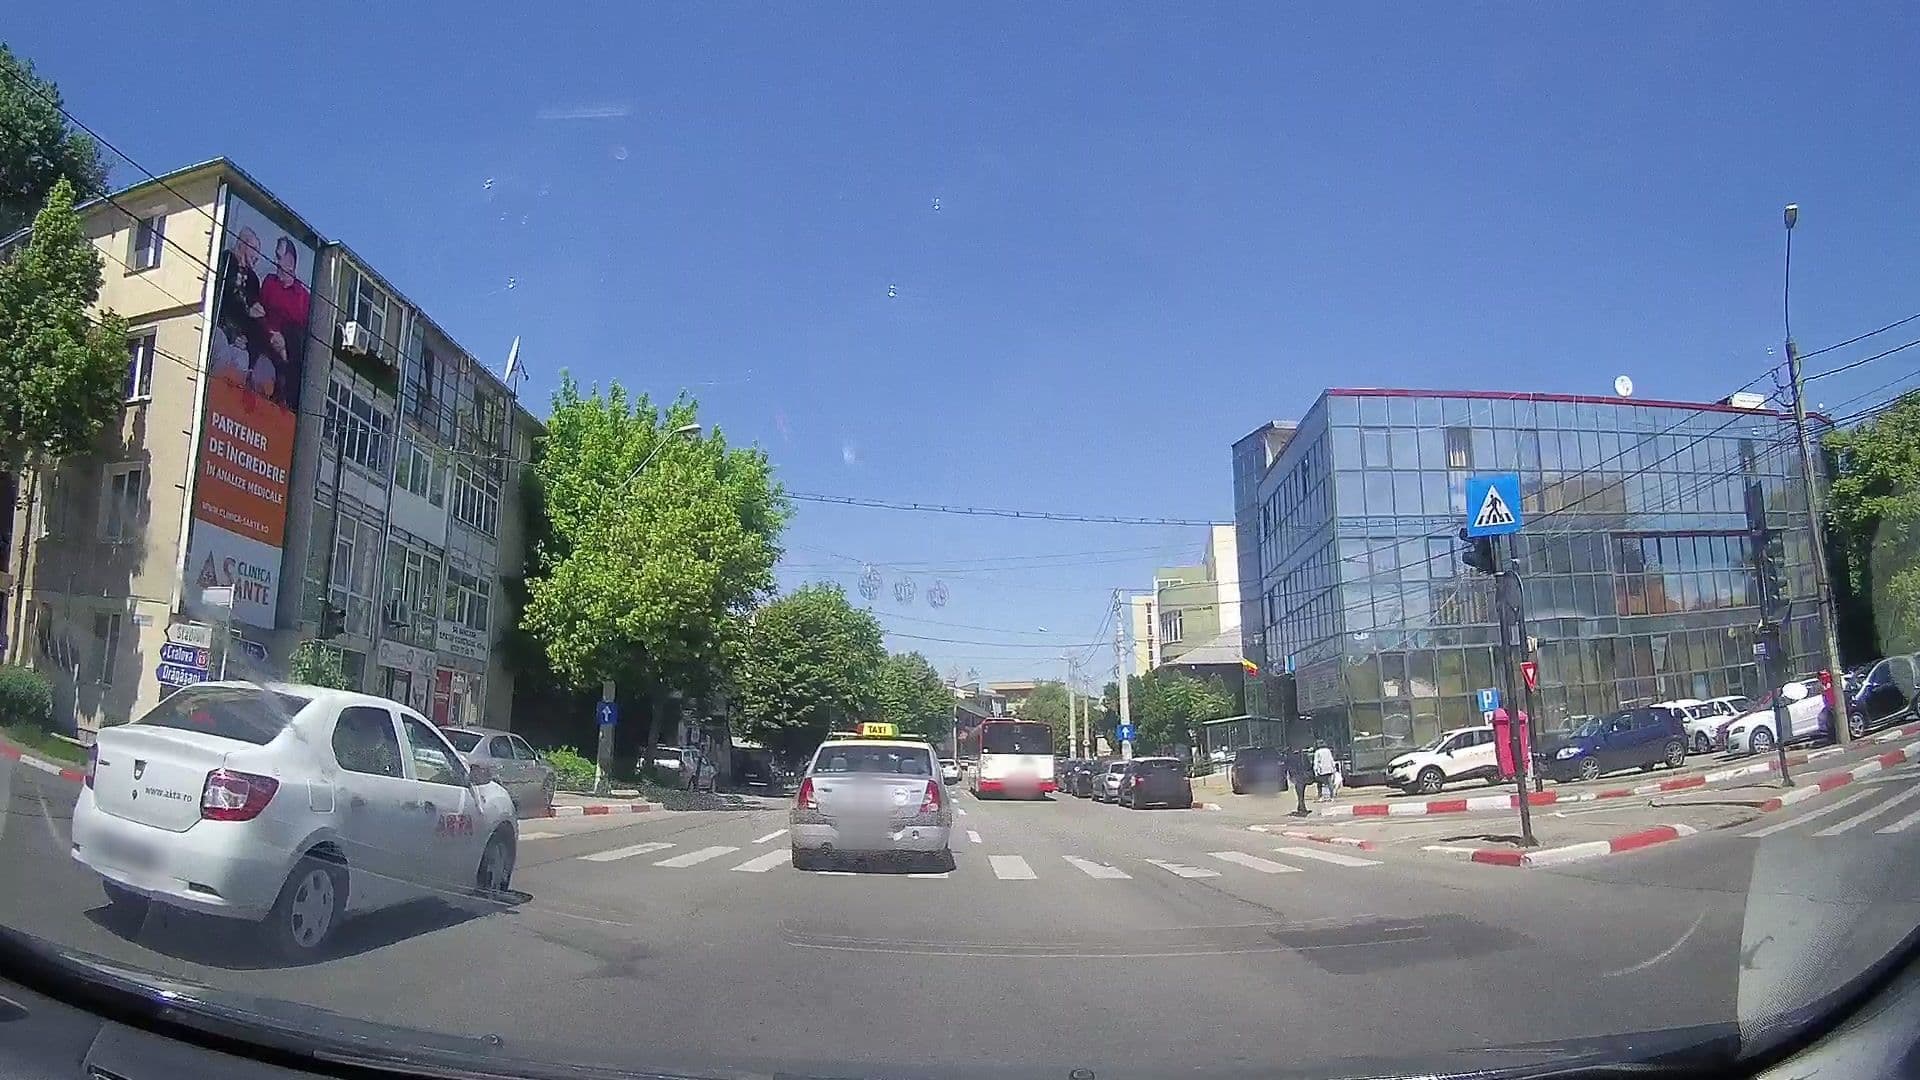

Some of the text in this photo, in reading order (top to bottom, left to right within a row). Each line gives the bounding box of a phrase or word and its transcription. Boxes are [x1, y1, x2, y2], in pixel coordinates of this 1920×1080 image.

[211, 412, 268, 452] PARTENER
[209, 437, 286, 485] DE ÎNCREDERE
[206, 461, 284, 505] ÎN ANALIZE MEDICALE
[238, 562, 271, 584] CLINICA
[167, 645, 194, 662] Craiova
[1483, 691, 1493, 709] P
[868, 725, 887, 734] TAXI
